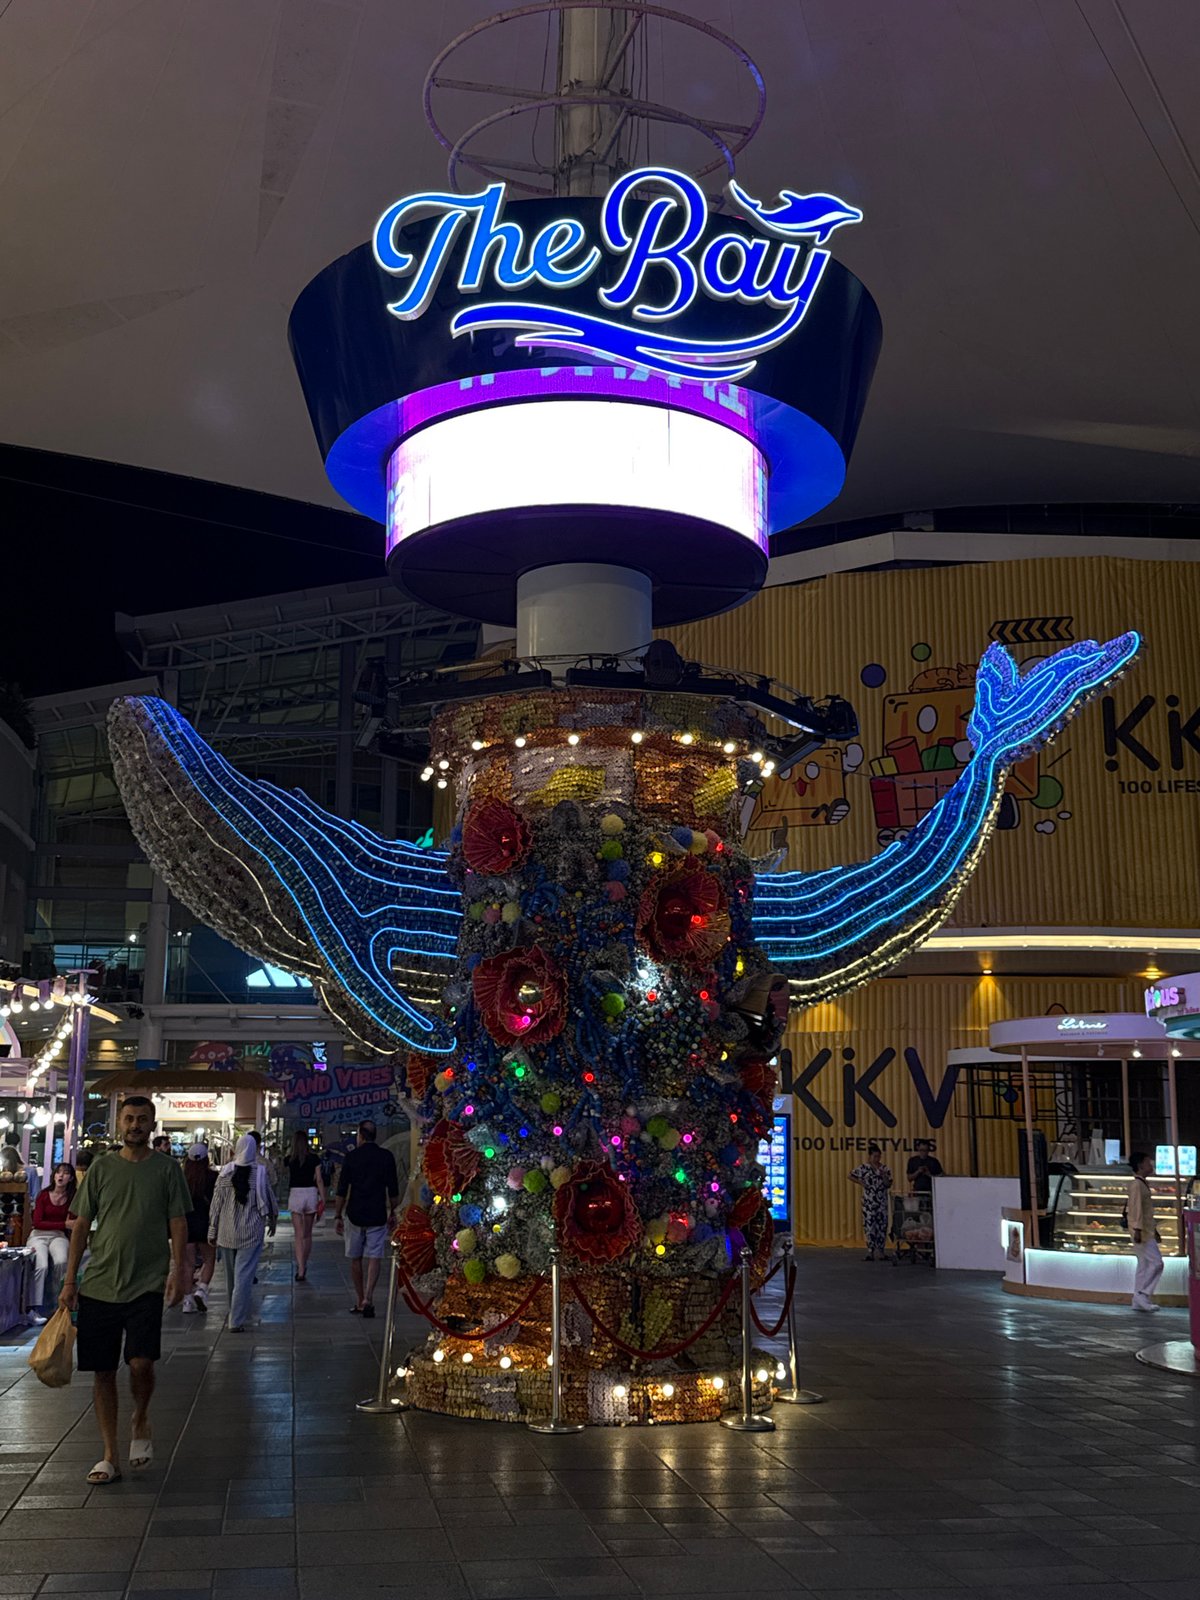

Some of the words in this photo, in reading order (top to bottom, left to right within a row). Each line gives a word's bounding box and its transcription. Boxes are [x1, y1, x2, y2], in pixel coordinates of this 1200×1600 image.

[373, 182, 601, 317] The
[598, 167, 831, 322] Bay
[1118, 781, 1152, 793] 100
[334, 1066, 394, 1092] VIBES
[315, 1089, 390, 1113] JUNGCEYLON
[793, 1137, 825, 1150] 100
[830, 1137, 937, 1152] LIFESTYLES
